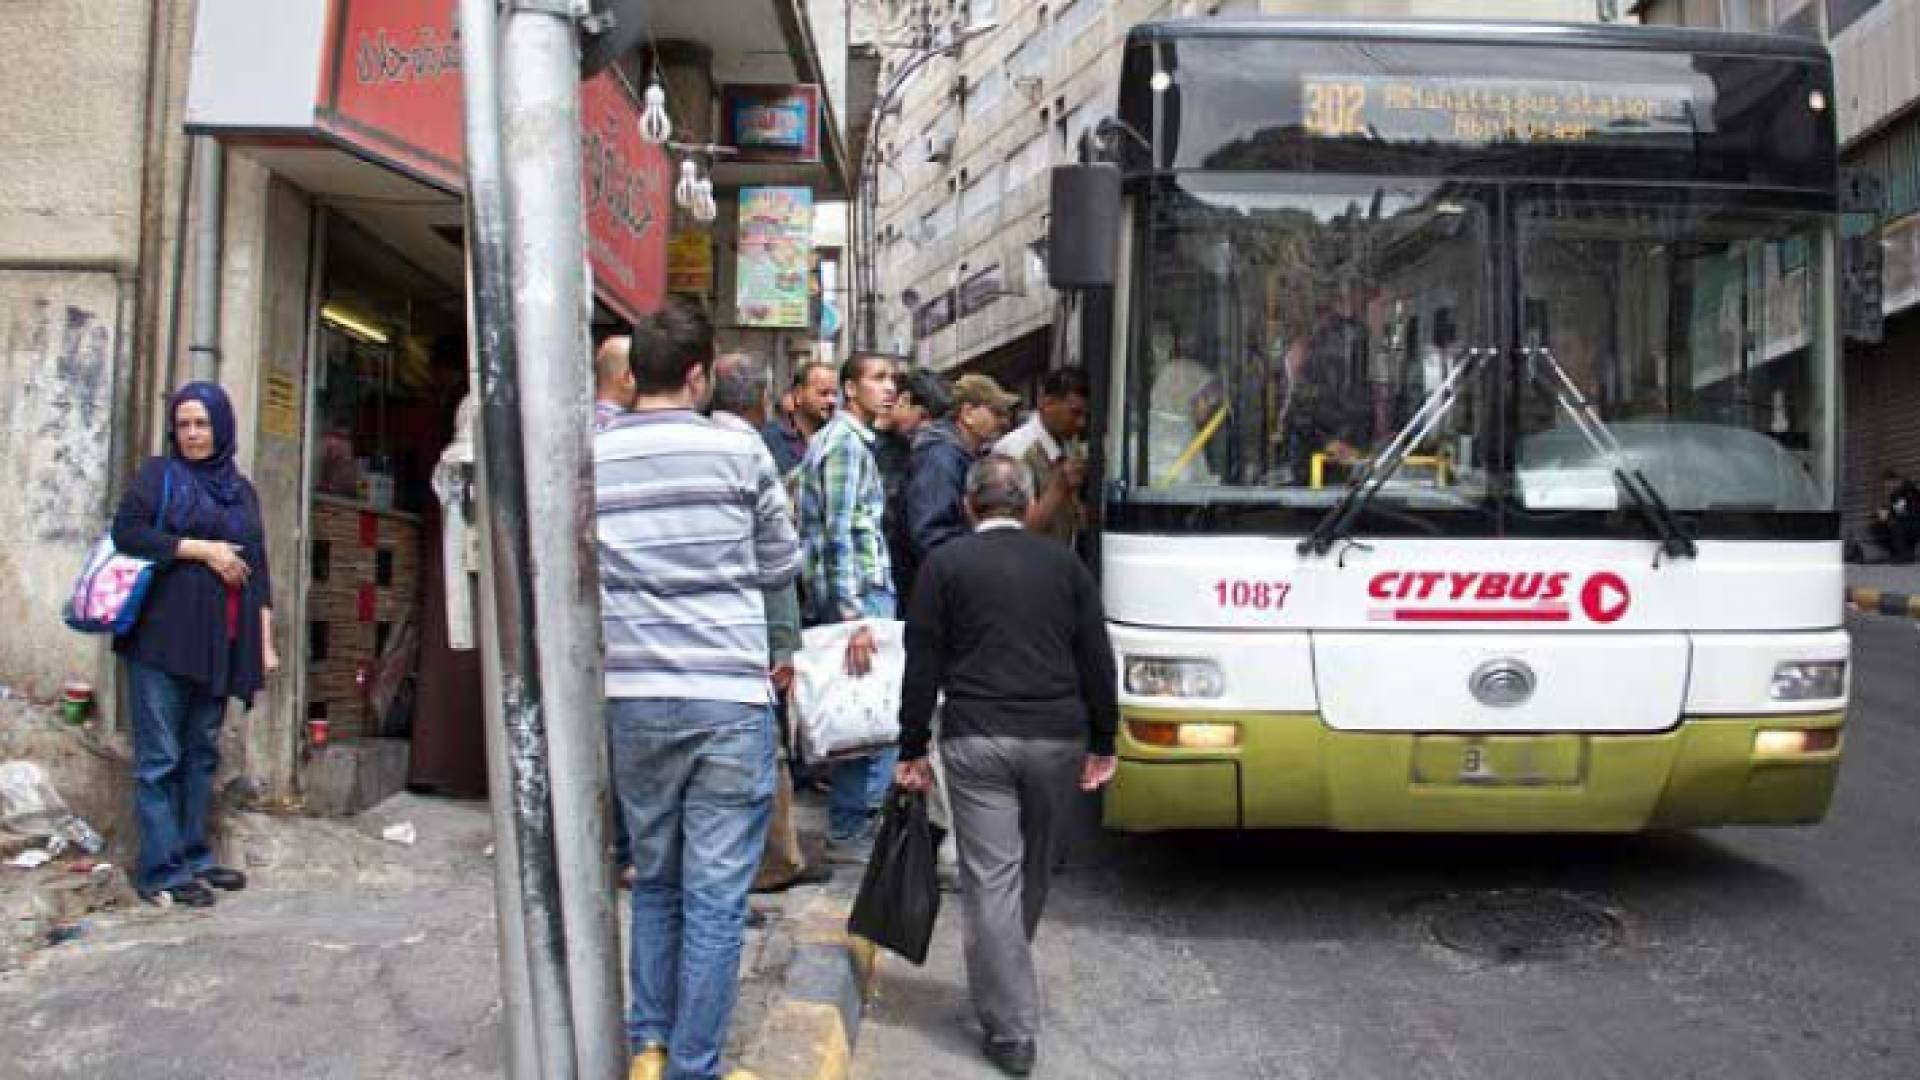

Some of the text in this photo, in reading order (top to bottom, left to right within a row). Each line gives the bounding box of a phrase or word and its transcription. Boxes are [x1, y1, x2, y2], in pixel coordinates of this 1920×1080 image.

[1305, 82, 1365, 134] 302
[1213, 579, 1292, 609] 1087
[1368, 571, 1570, 600] CITYBUS
